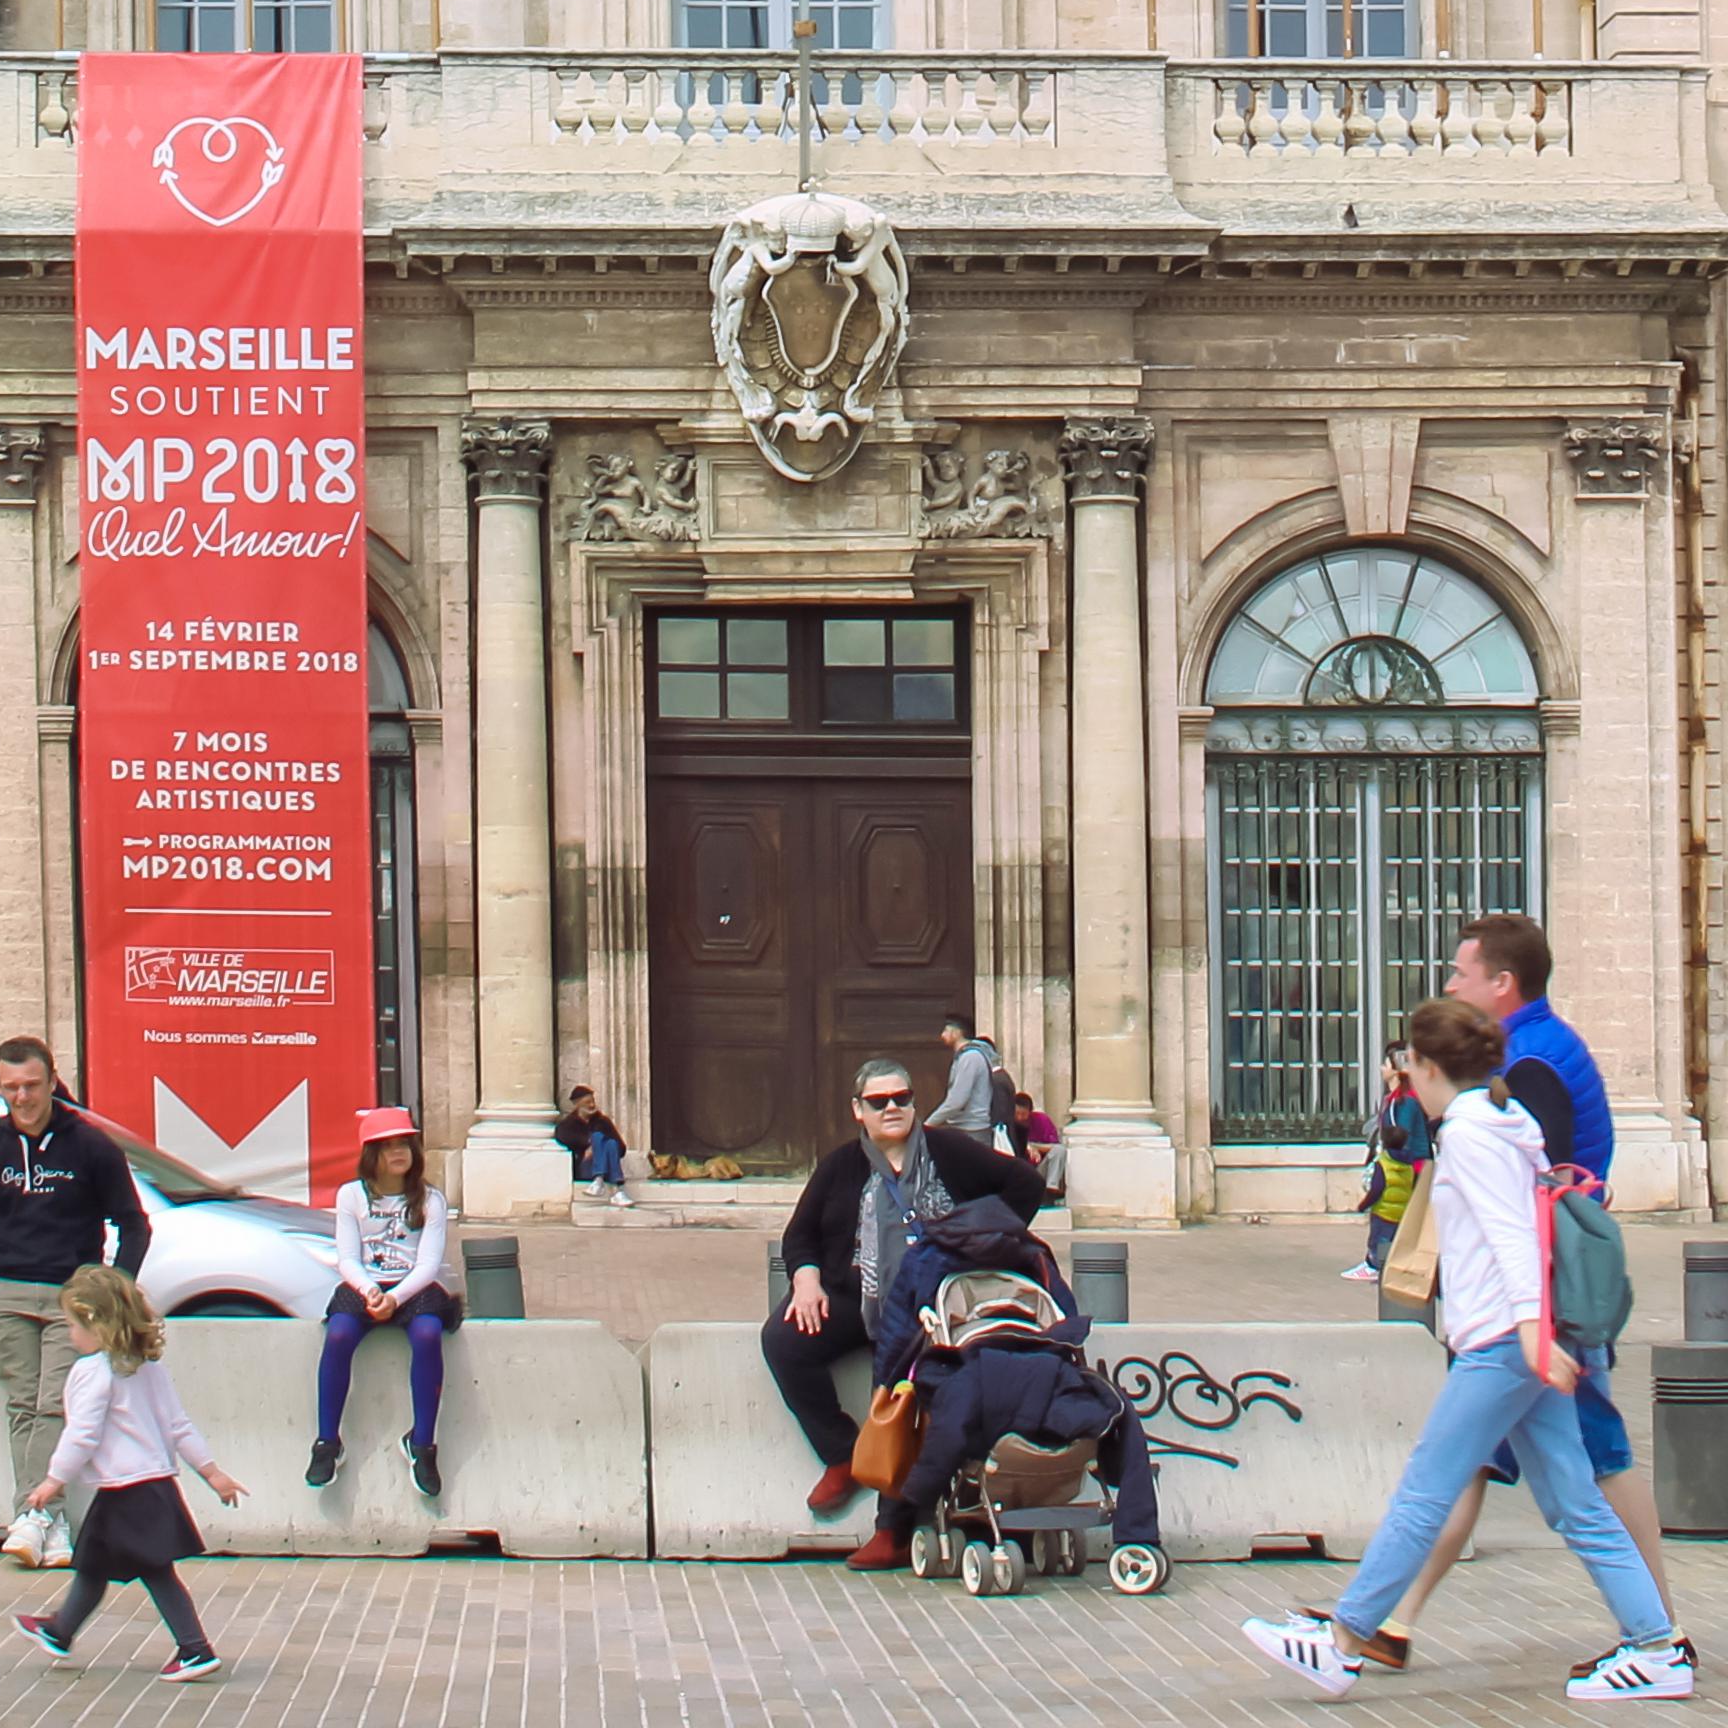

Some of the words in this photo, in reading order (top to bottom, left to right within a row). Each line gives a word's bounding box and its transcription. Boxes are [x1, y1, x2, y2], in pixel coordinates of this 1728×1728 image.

[86, 327, 353, 370] MARSEILLE
[111, 386, 329, 415] SOUTIENT
[87, 438, 355, 503] MP2018
[88, 506, 185, 561] Quel
[193, 508, 360, 557] Amour!
[147, 622, 174, 640] 14
[186, 616, 298, 641] FÉVRIER
[89, 651, 120, 669] 1ER
[130, 651, 286, 670] SEPTEMBRE
[297, 652, 357, 671] 2018
[173, 732, 188, 751] 7
[198, 732, 267, 752] MOIS
[112, 760, 144, 779] DE
[157, 761, 340, 782] RENCONTRES
[136, 790, 315, 810] ARTISTIQUES
[160, 835, 330, 850] PROGRAMMATION
[124, 856, 330, 880] MP2018.COM
[182, 954, 220, 967] VILLE
[222, 955, 244, 967] DE
[177, 971, 328, 994] MARSEILLE
[169, 995, 290, 1007] www.marseille.fr
[144, 1030, 181, 1042] Nous
[186, 1034, 247, 1043] sommes
[252, 1033, 317, 1044] Marseille
